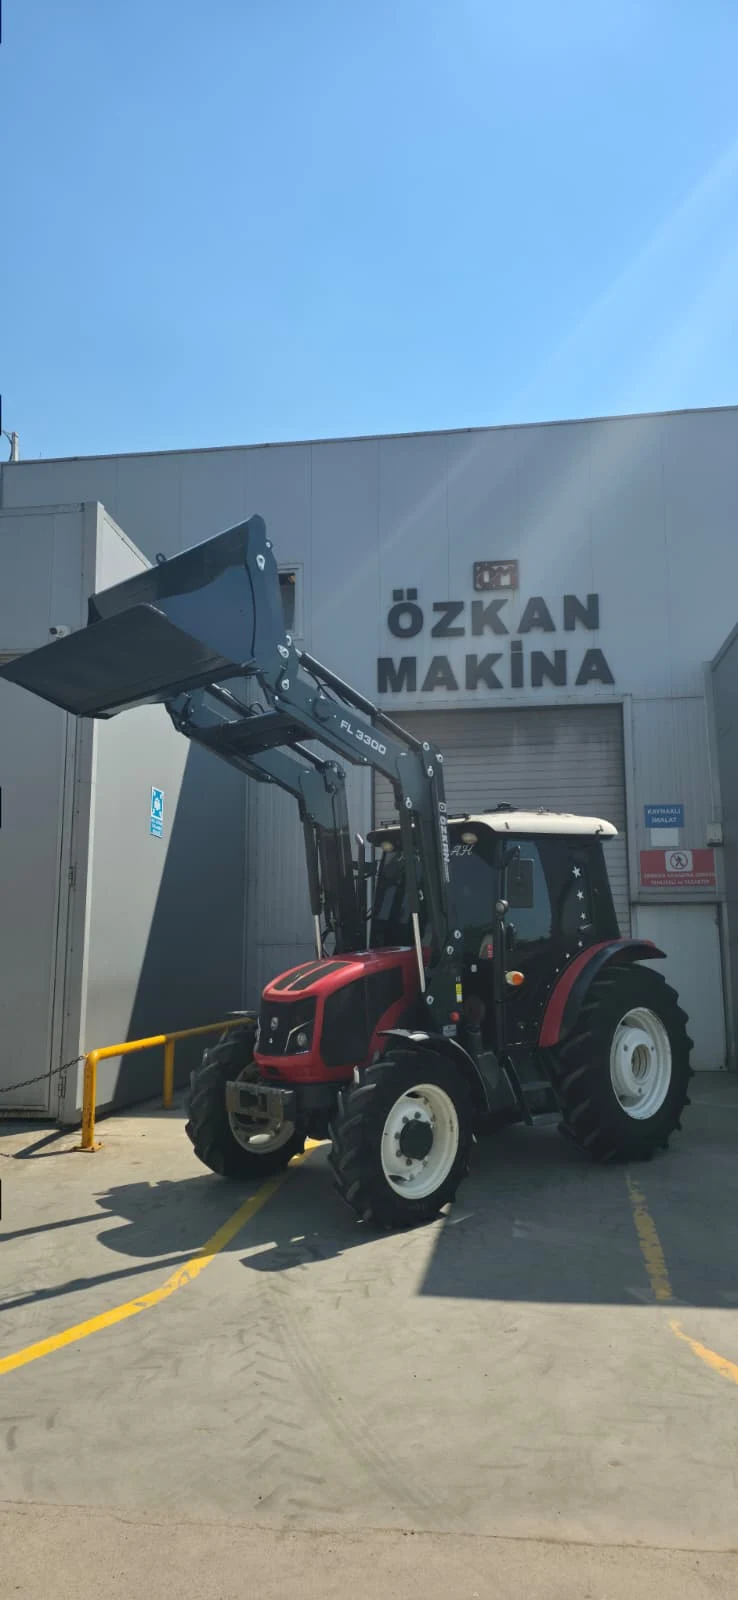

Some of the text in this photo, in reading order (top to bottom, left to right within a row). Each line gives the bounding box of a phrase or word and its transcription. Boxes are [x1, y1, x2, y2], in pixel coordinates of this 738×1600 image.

[387, 588, 599, 638] ÖZKAN
[377, 640, 615, 693] MAKİNA
[340, 719, 387, 756] FL 3300
